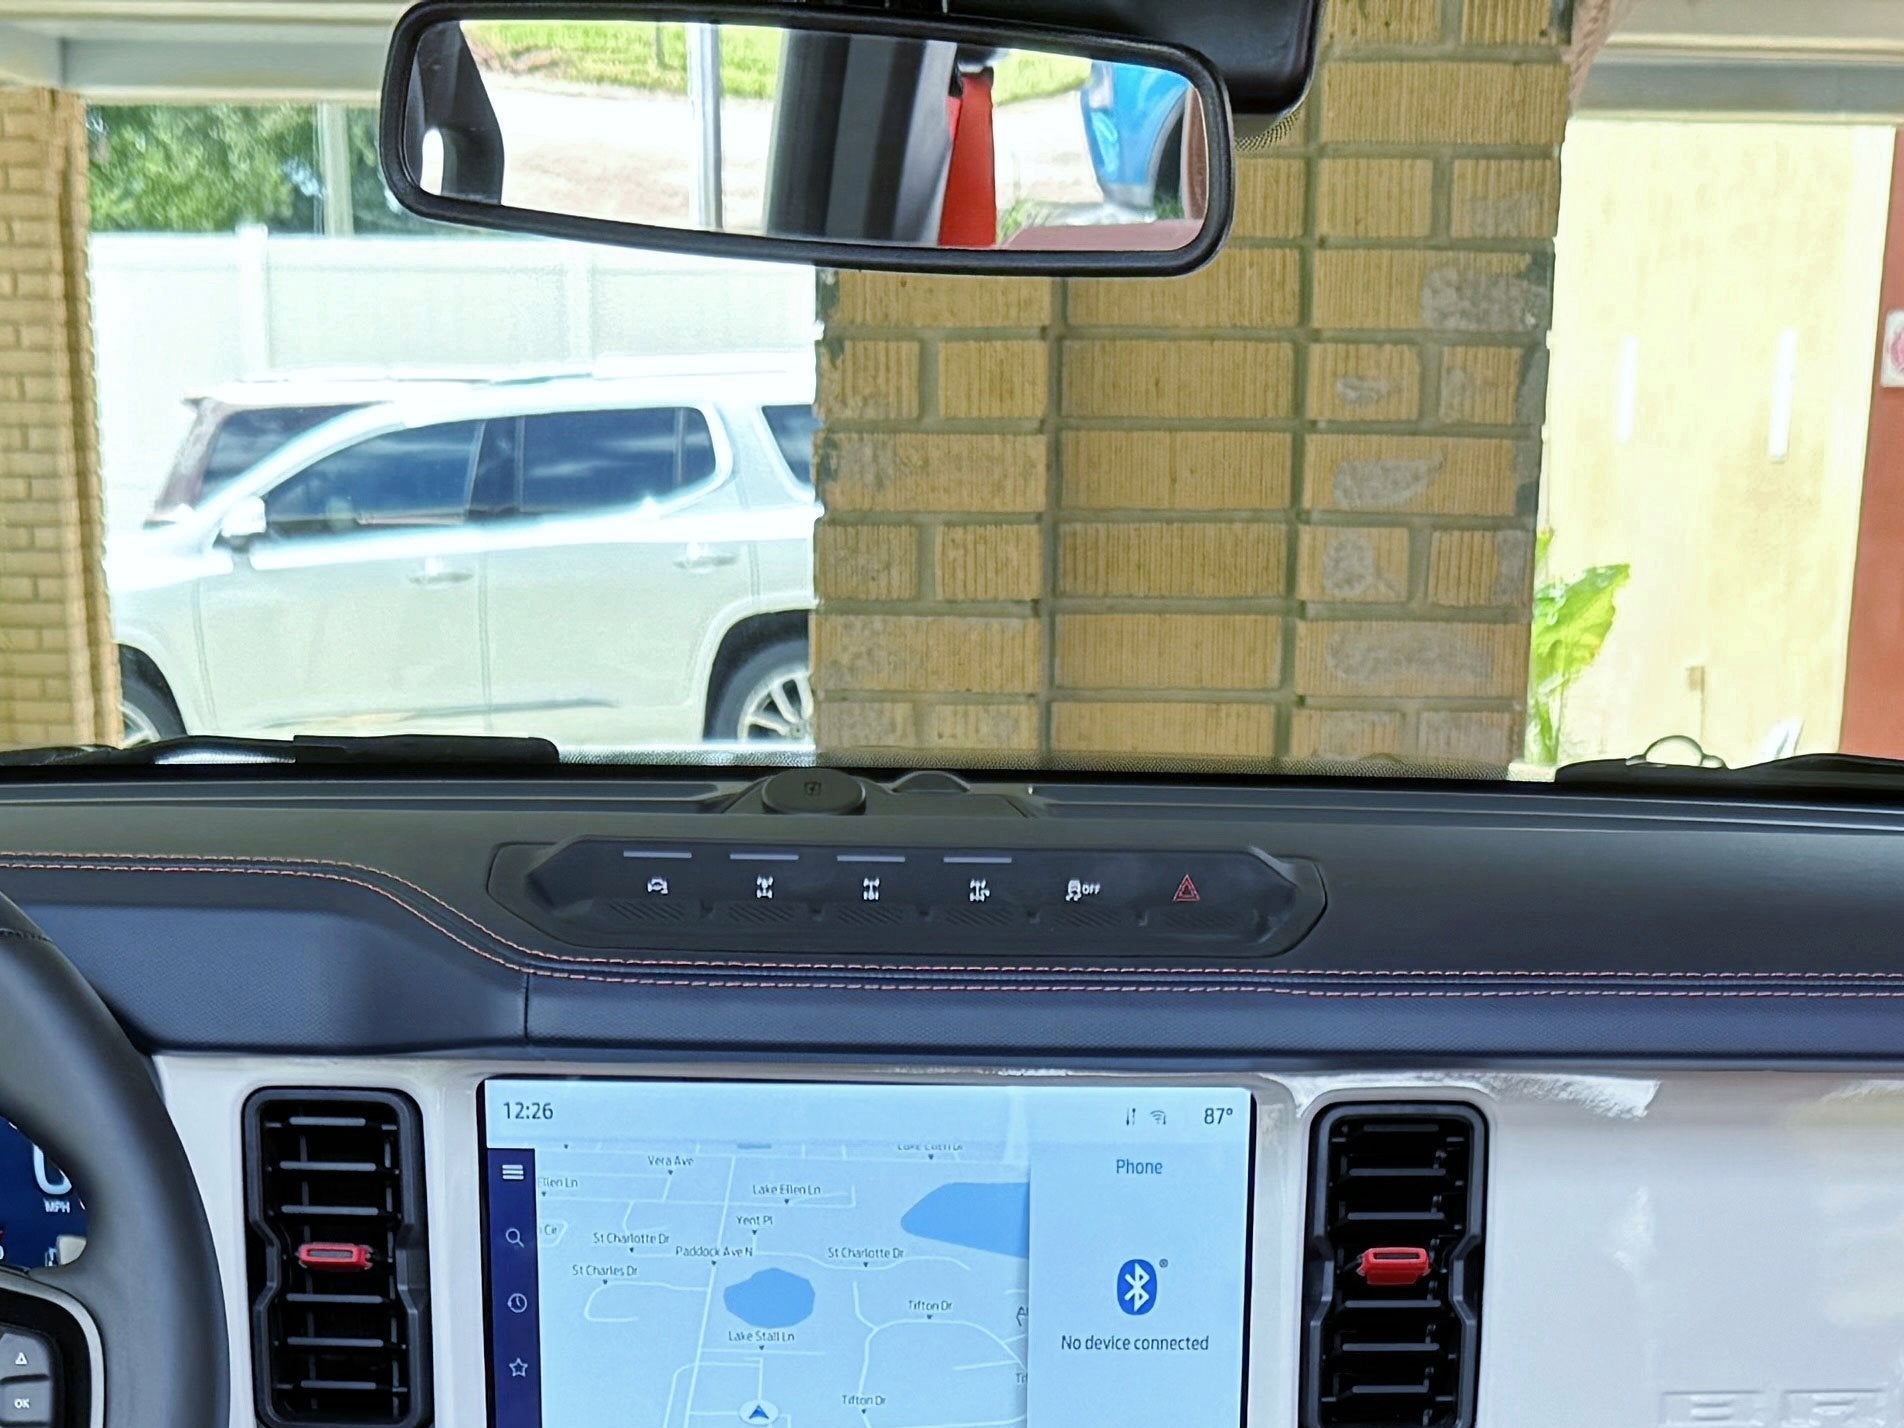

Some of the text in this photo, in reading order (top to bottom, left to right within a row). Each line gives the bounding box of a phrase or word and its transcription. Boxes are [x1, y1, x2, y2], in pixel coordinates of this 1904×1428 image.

[503, 1101, 554, 1120] 12:26
[1204, 1107, 1234, 1125] 87°
[647, 1155, 694, 1166] Vera Ave
[1116, 1159, 1163, 1175] Phone
[565, 1177, 578, 1188] Ln
[753, 1184, 821, 1195] Lake Ellen Ln
[43, 1199, 71, 1213] MPH
[593, 1232, 670, 1245] St Charlotte Dr
[675, 1245, 753, 1258] Paddock Ave N
[828, 1247, 904, 1258] St Charlotte Dr
[572, 1265, 638, 1276] St Charles Dr
[909, 1300, 952, 1311] Tifton Dr
[728, 1330, 795, 1342] Lake Stall Ln
[1061, 1335, 1209, 1351] No device connected
[14, 1397, 30, 1410] OK
[842, 1395, 886, 1406] Tifton Dr
